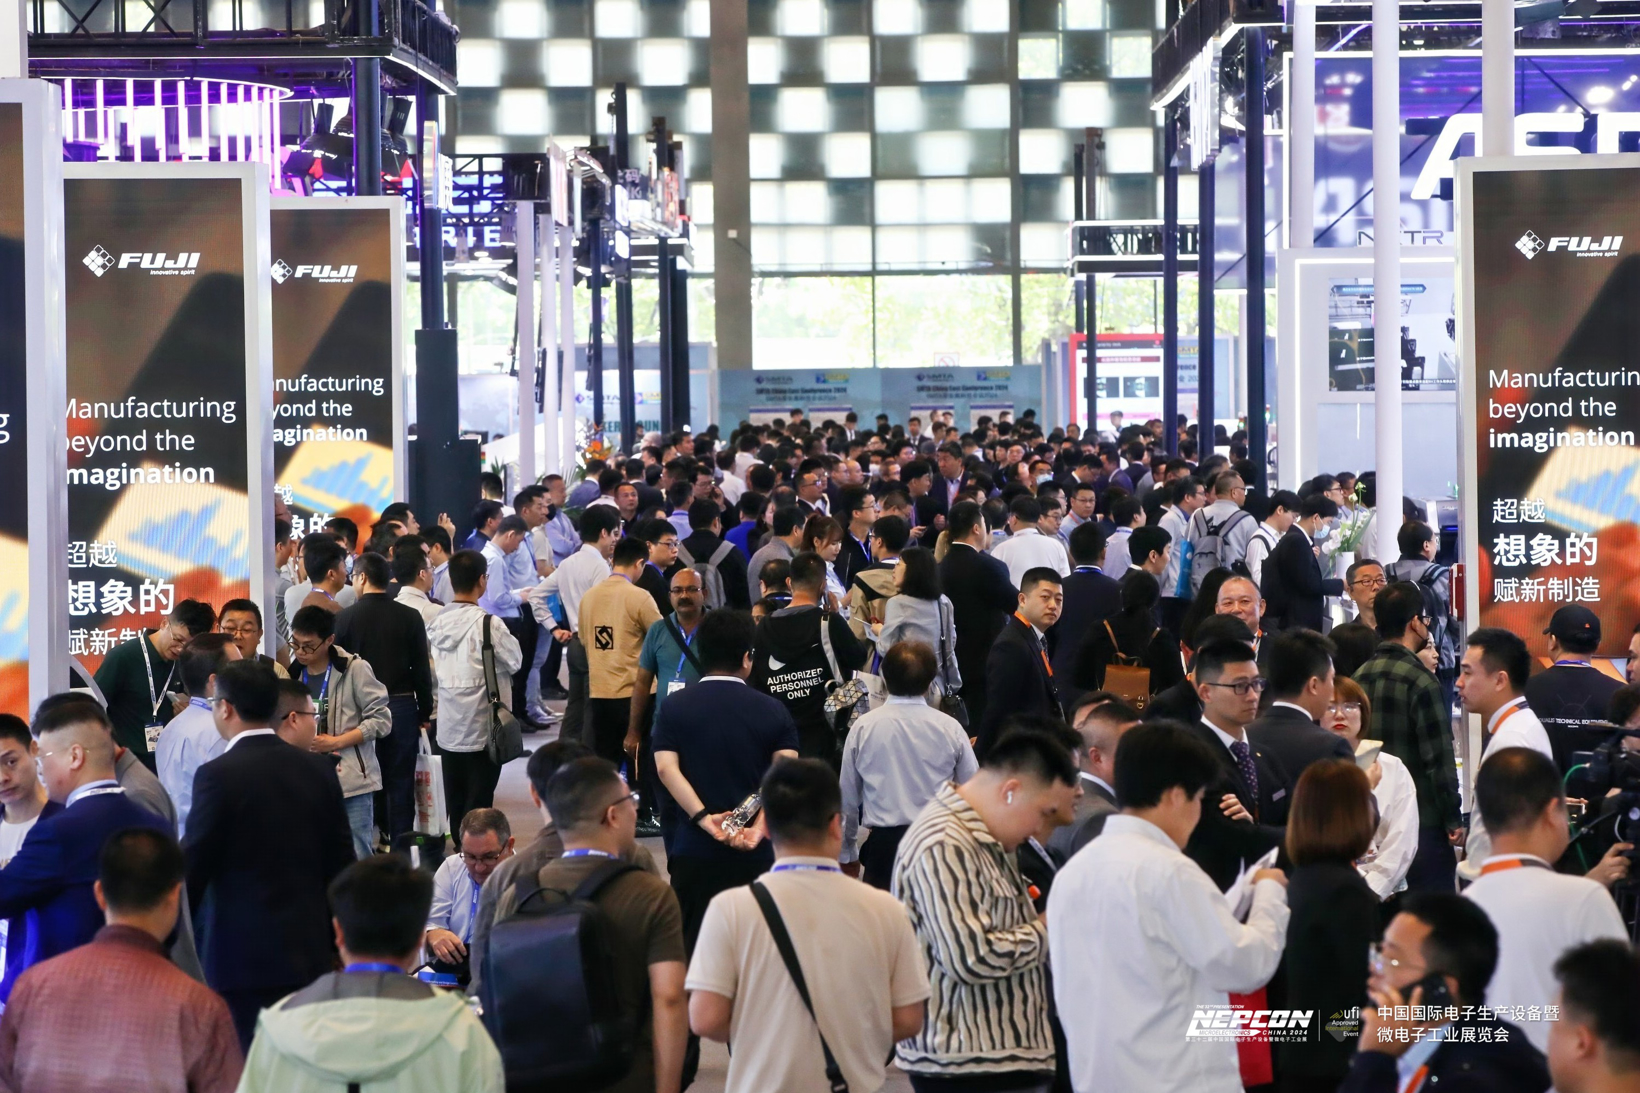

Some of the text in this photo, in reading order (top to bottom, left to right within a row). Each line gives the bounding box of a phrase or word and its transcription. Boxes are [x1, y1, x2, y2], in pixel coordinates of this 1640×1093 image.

[1357, 230, 1444, 246] NTR
[1547, 236, 1624, 252] FUJI
[118, 252, 201, 269] FUJI
[294, 265, 358, 278] FUJI
[273, 374, 385, 396] nufacturing
[321, 399, 353, 417] the
[1489, 397, 1617, 423] beyond the
[155, 429, 195, 450] the
[1489, 427, 1635, 453] imagination
[1492, 498, 1546, 523] 超越
[1492, 532, 1598, 567] 想象的
[68, 578, 175, 616] 想象的
[1493, 576, 1601, 603] 赋新制造
[767, 668, 823, 685] AUTHORIZED
[770, 676, 824, 693] PERSONNEL
[787, 688, 811, 700] ONLY
